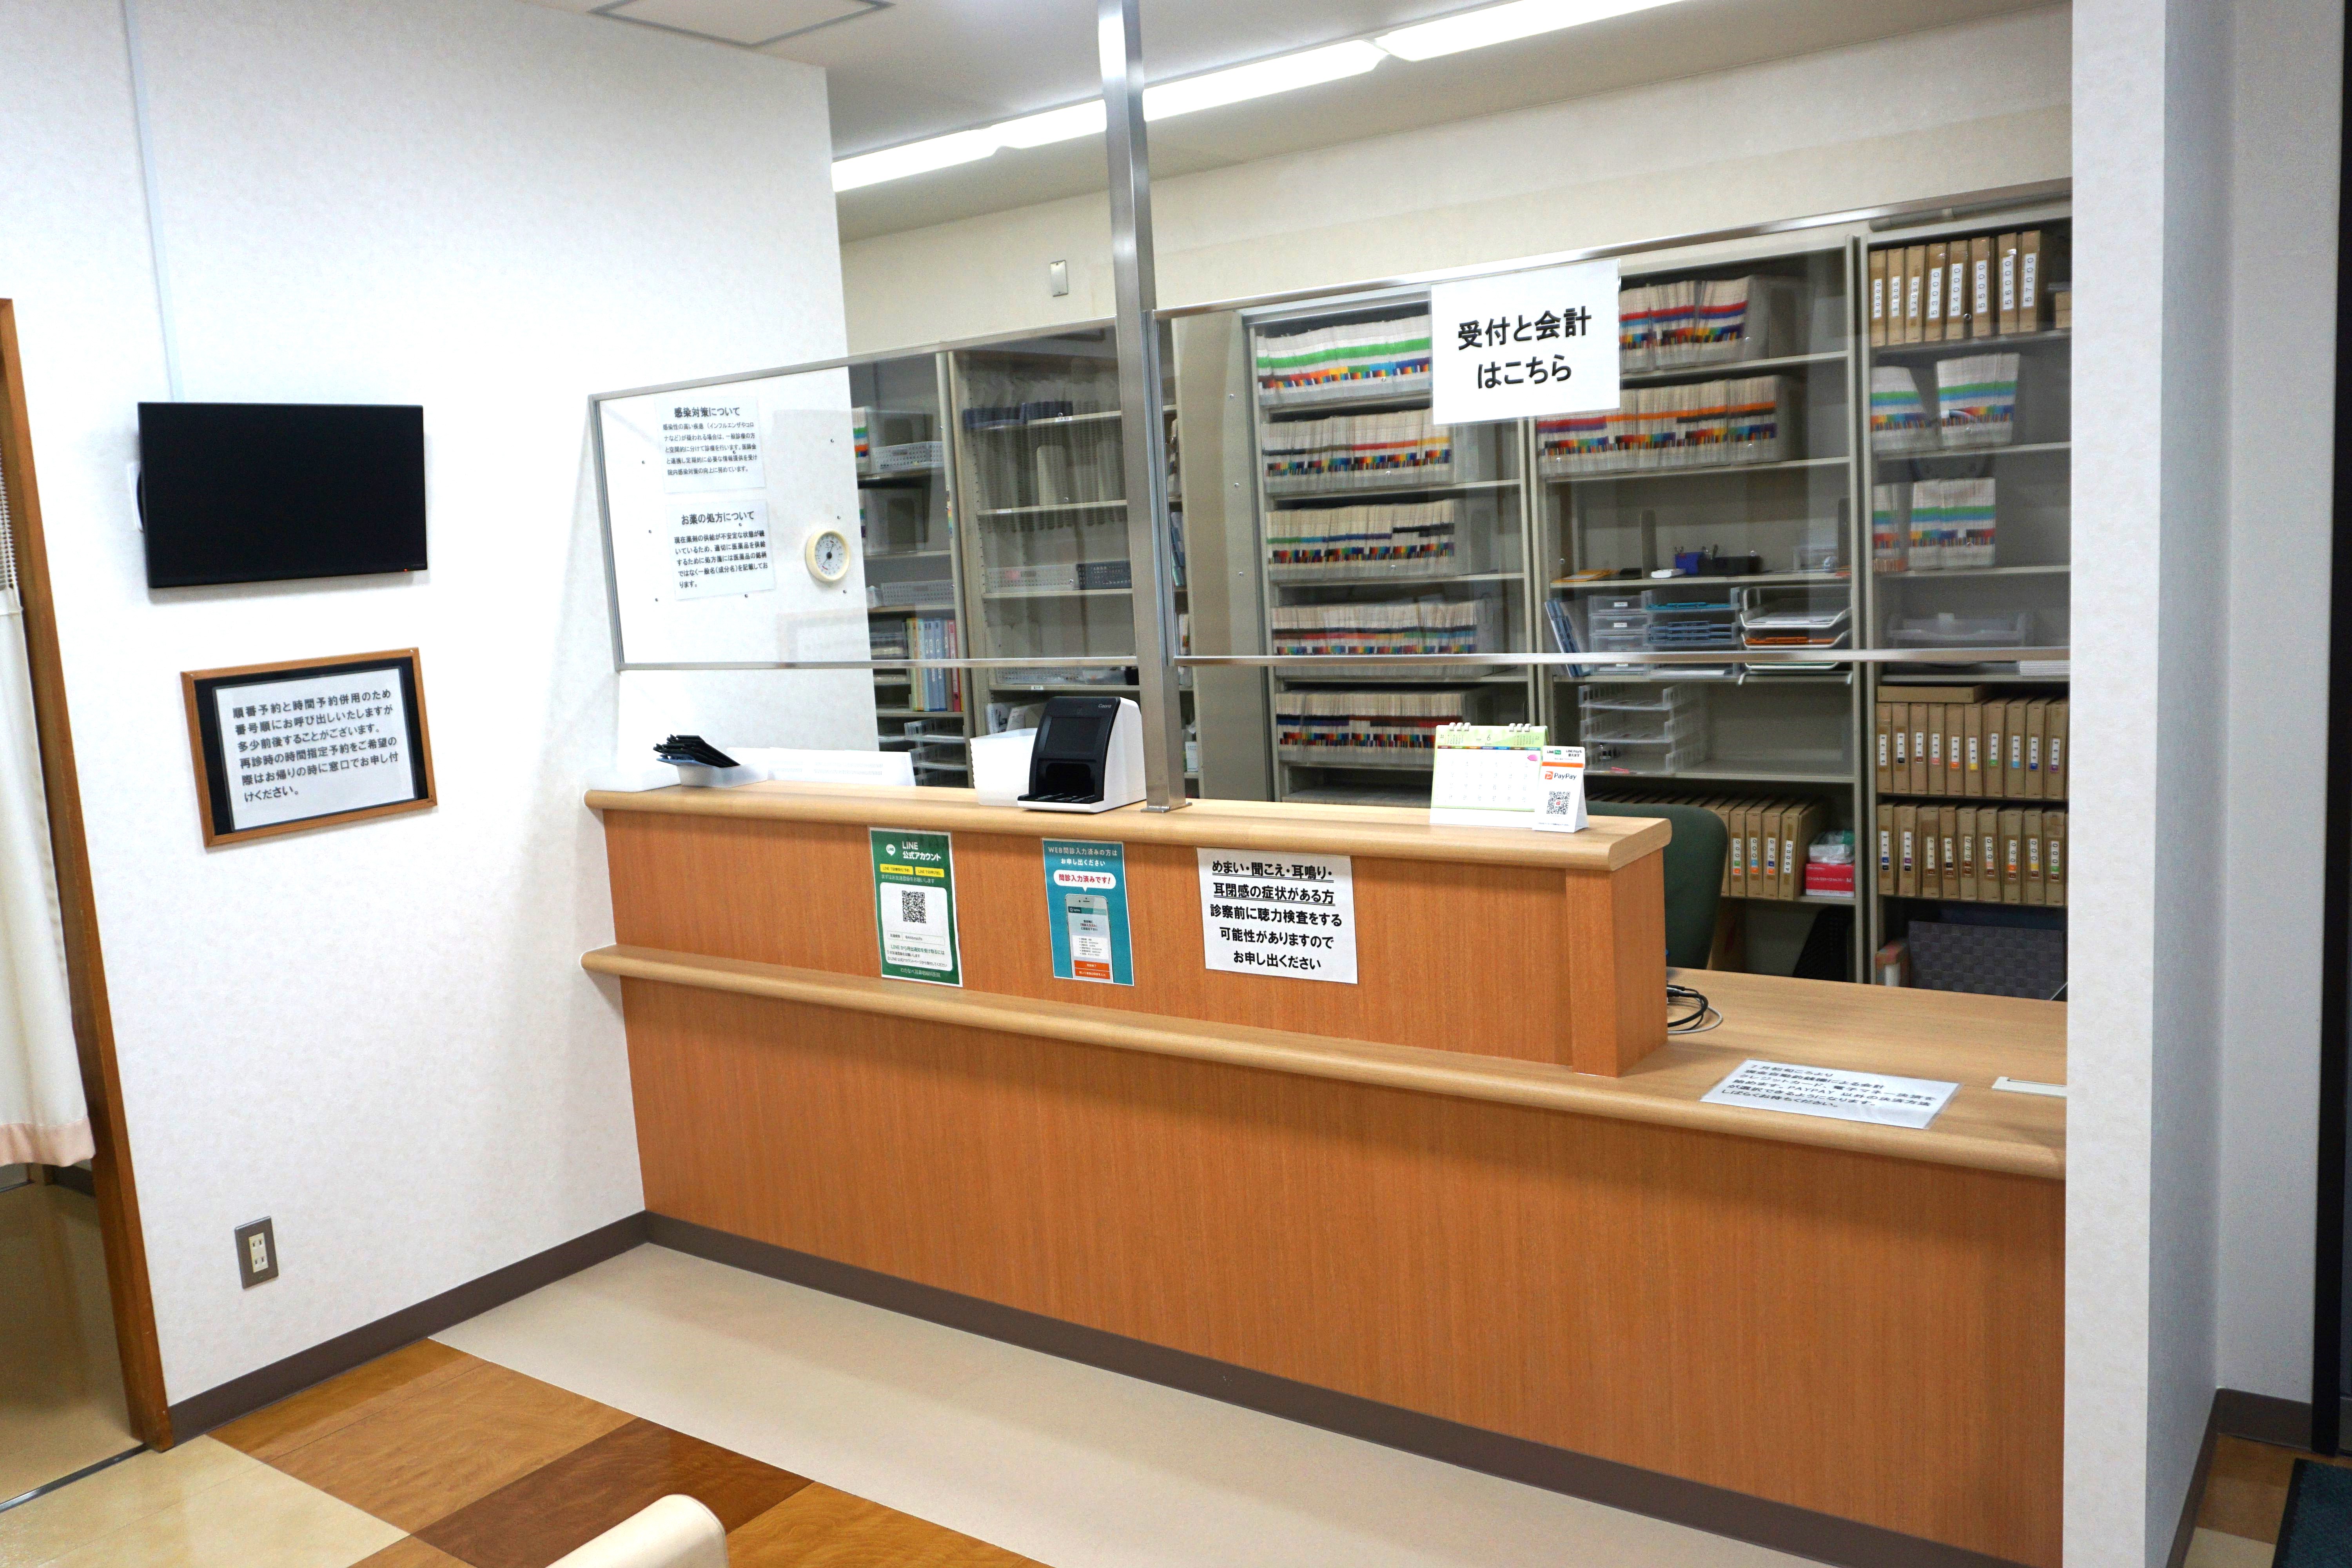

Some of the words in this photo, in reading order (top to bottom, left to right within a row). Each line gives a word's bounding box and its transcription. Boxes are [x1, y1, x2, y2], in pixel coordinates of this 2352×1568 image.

[1952, 268, 1960, 311] 54000
[2025, 257, 2034, 302] 57000
[1931, 272, 1939, 315] 53000
[1458, 305, 1592, 351] 受付と会計
[1477, 354, 1572, 389] はこちら
[674, 407, 740, 417] 感染対策について
[681, 511, 754, 524] お薬の処方について
[674, 530, 764, 544] 現在薬剤の供給が不安定な状態が続
[675, 541, 766, 554] いているため、適切に医薬品を供給
[233, 689, 391, 719] 順番予約と時間予約併用のため
[236, 704, 393, 735] 番号順にお呼び出しいたしますが
[237, 723, 379, 752] 多少前後することがございます。
[240, 737, 396, 769] 再診時の時間指定予約をご希望の
[241, 752, 398, 786] 際はお帰りの時に窓口でお申し付
[244, 785, 299, 802] けください。
[902, 841, 918, 850] LINE
[902, 851, 941, 861] 公式アカウント
[1048, 847, 1117, 856] WEB問診入力済みの方は
[1061, 858, 1105, 866] お申し出ください
[1212, 860, 1332, 880] めまい・聞こえ・耳鳴り・
[1059, 874, 1111, 884] 問診入力済みです!
[1214, 882, 1334, 904] 耳閉感の症状がある方
[1210, 904, 1342, 927] 診察前に聴力検査をする
[1220, 926, 1334, 949] 可能性がありますので
[1234, 951, 1321, 970] お申し出ください
[1722, 1090, 1838, 1107] しばらくお待ちください。
